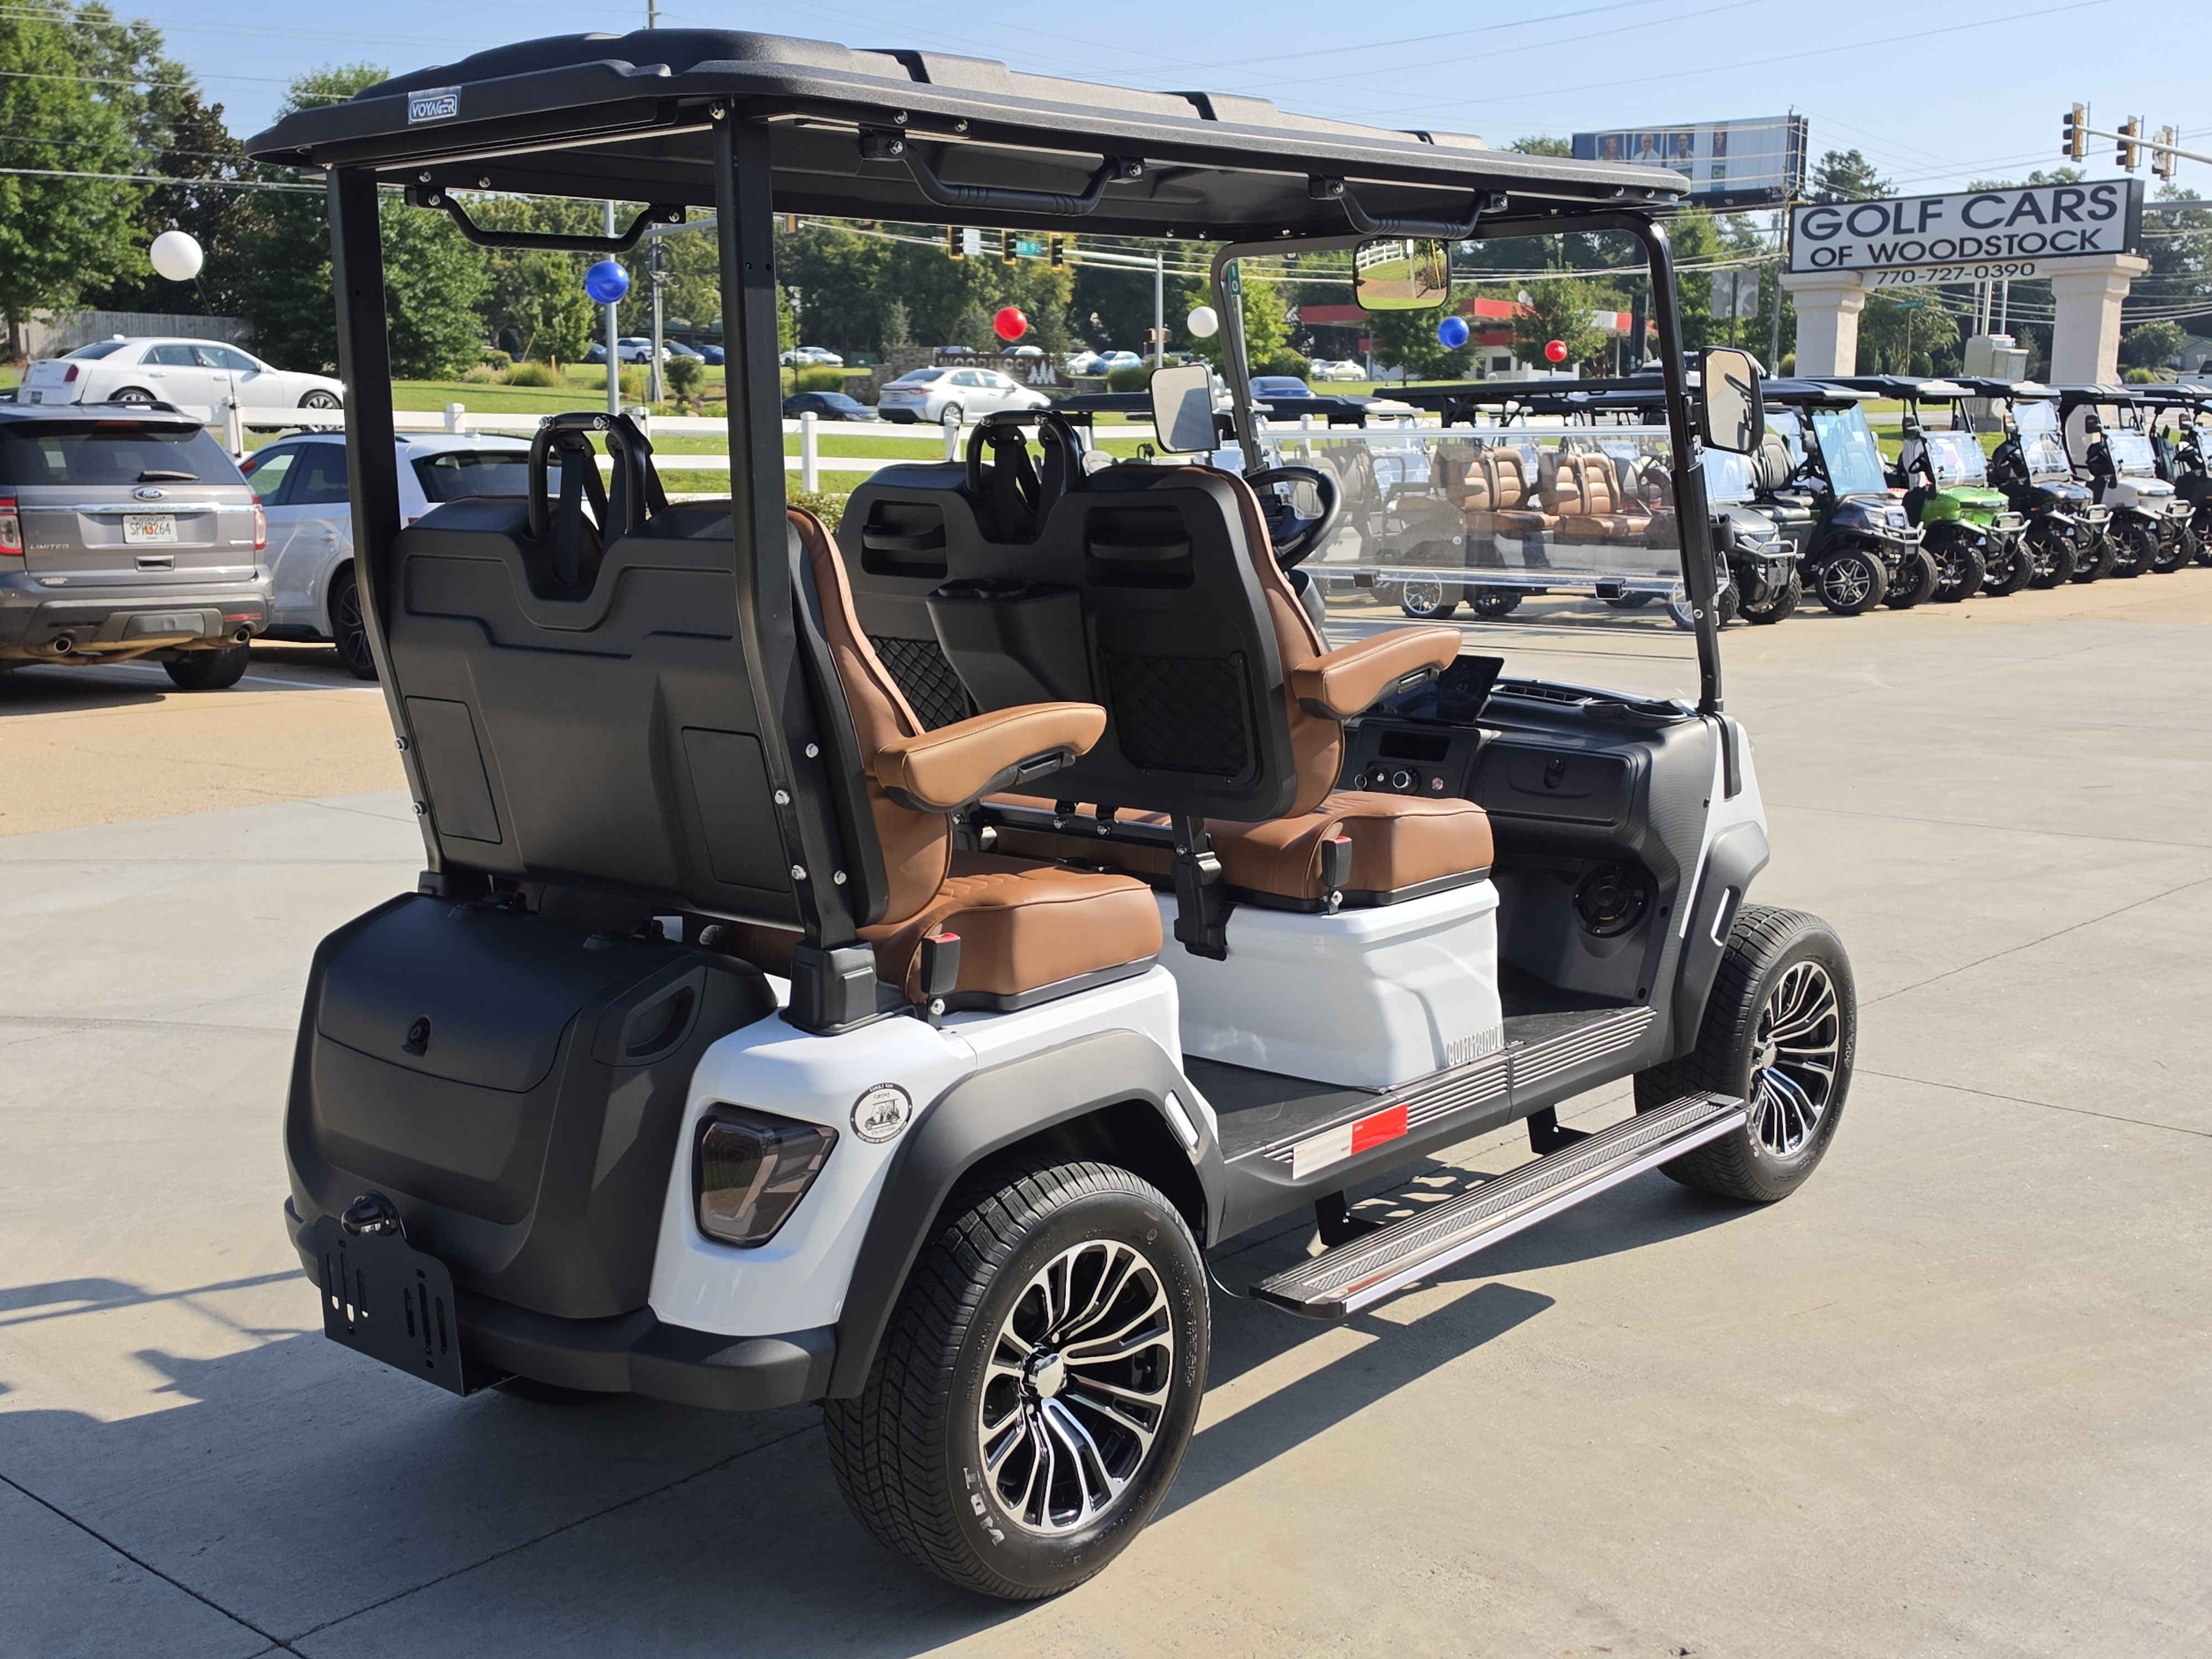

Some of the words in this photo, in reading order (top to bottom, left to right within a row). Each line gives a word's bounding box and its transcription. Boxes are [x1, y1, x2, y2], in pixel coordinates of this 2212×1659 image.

[413, 98, 455, 117] VOYAGER
[1801, 199, 1943, 241] GOLF
[1961, 185, 2117, 229] CARS
[1810, 245, 1853, 267] OF
[1867, 228, 2103, 263] WOODSTOCK
[1876, 262, 2036, 285] 770-727-0390
